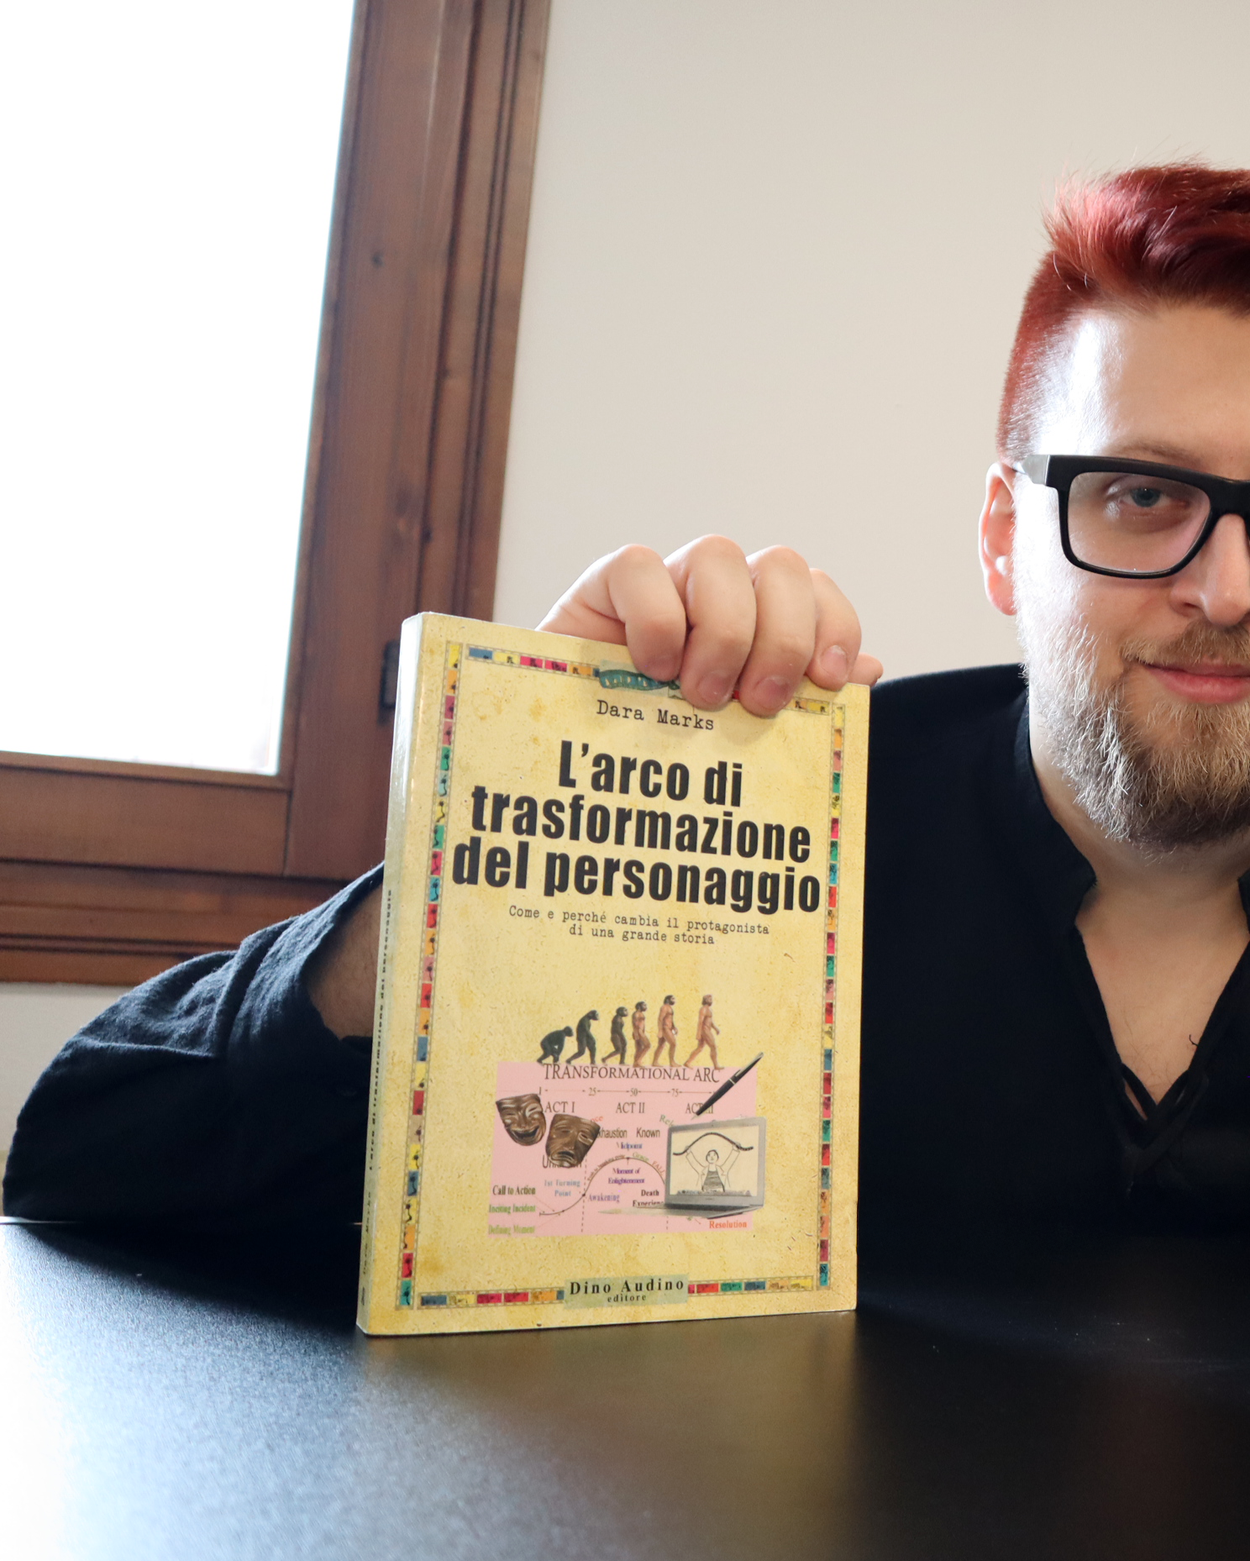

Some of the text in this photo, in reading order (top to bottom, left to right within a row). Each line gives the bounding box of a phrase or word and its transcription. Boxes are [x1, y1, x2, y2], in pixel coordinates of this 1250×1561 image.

[596, 700, 714, 730] Dara Marks
[558, 740, 742, 808] L'arco di
[471, 785, 811, 863] trasformazione
[452, 836, 820, 915] del personaggio
[509, 905, 770, 934] Come e perché cambia il protagonista
[569, 923, 715, 944] di una grande storia
[544, 1064, 719, 1083] TRANSFORMATIONAL ARC
[545, 1101, 575, 1113] ACT I
[616, 1102, 645, 1113] ACT II
[636, 1127, 660, 1138] Known
[493, 1185, 536, 1195] Call to Action
[709, 1220, 747, 1229] Resolution
[570, 1278, 683, 1295] Dino Audino
[607, 1293, 646, 1303] editore
